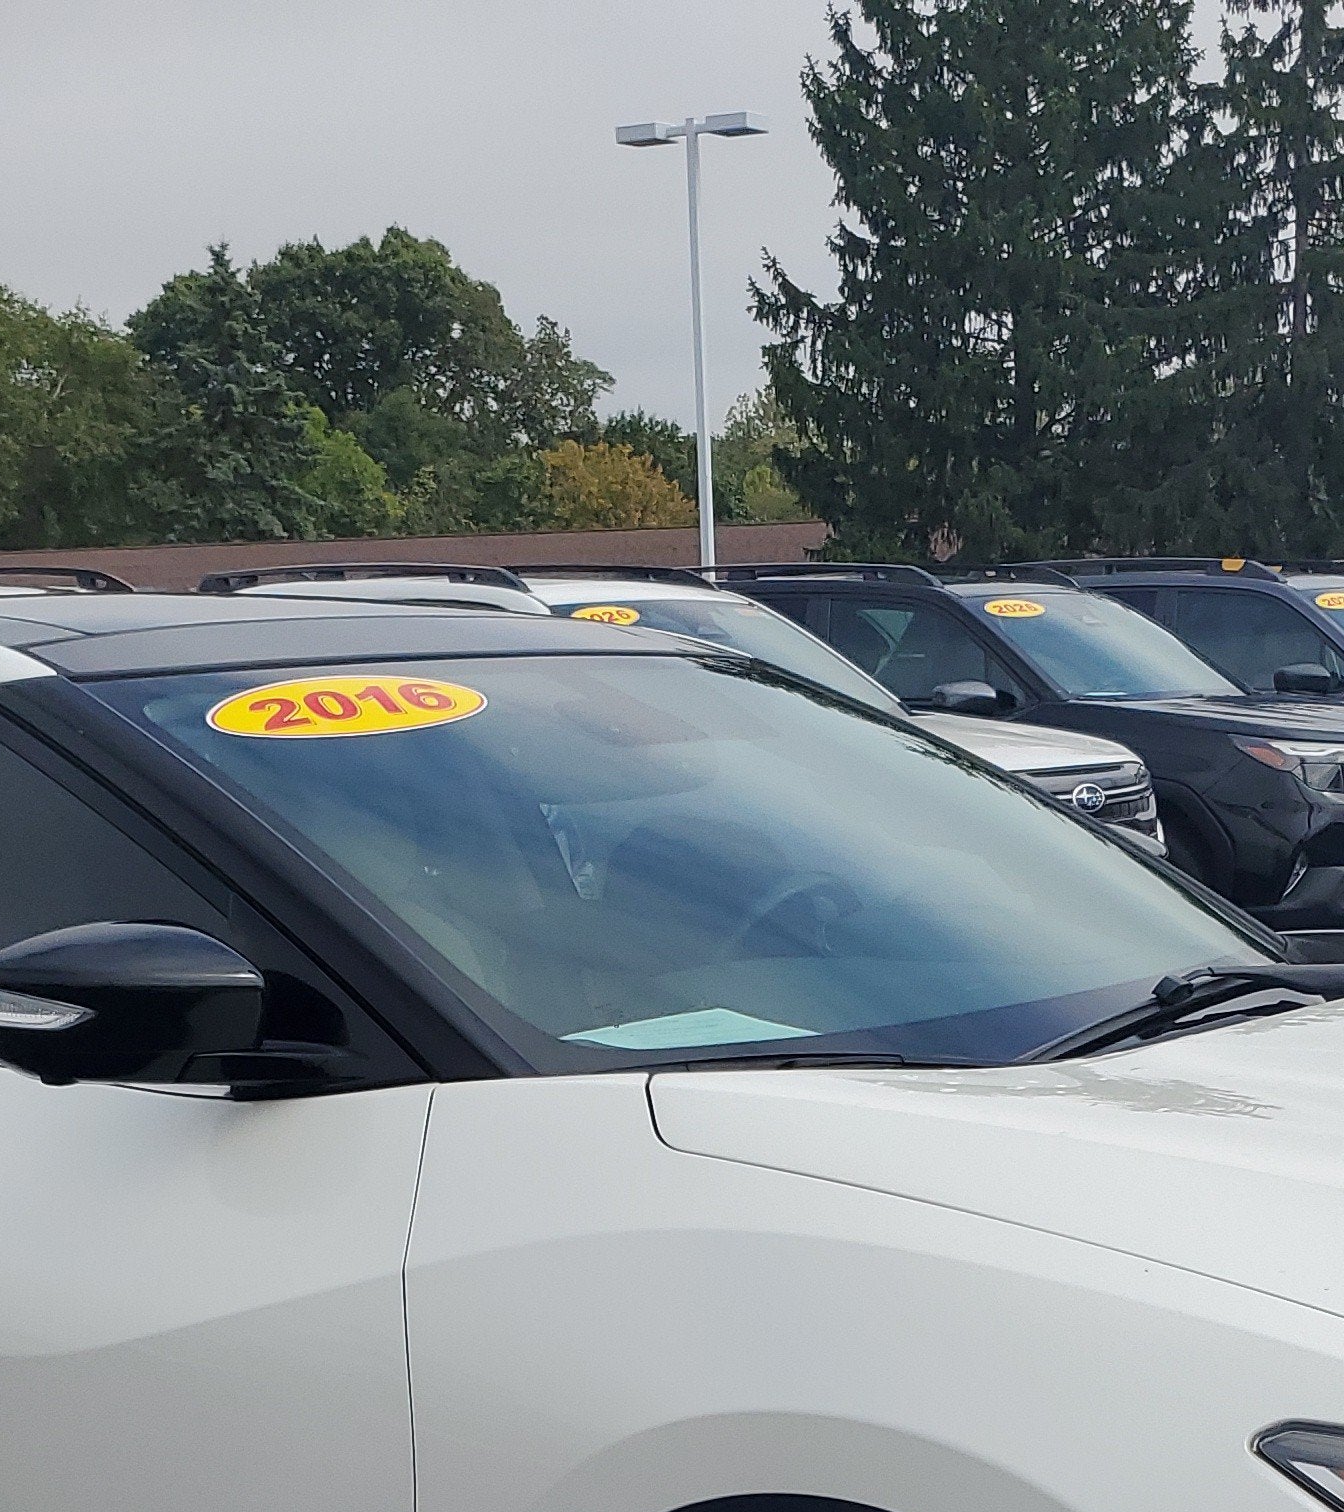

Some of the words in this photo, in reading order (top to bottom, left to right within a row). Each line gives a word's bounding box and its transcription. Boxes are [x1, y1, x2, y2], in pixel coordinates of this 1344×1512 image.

[992, 603, 1039, 614] 2026
[585, 609, 631, 623] 026
[248, 682, 457, 732] 2016
